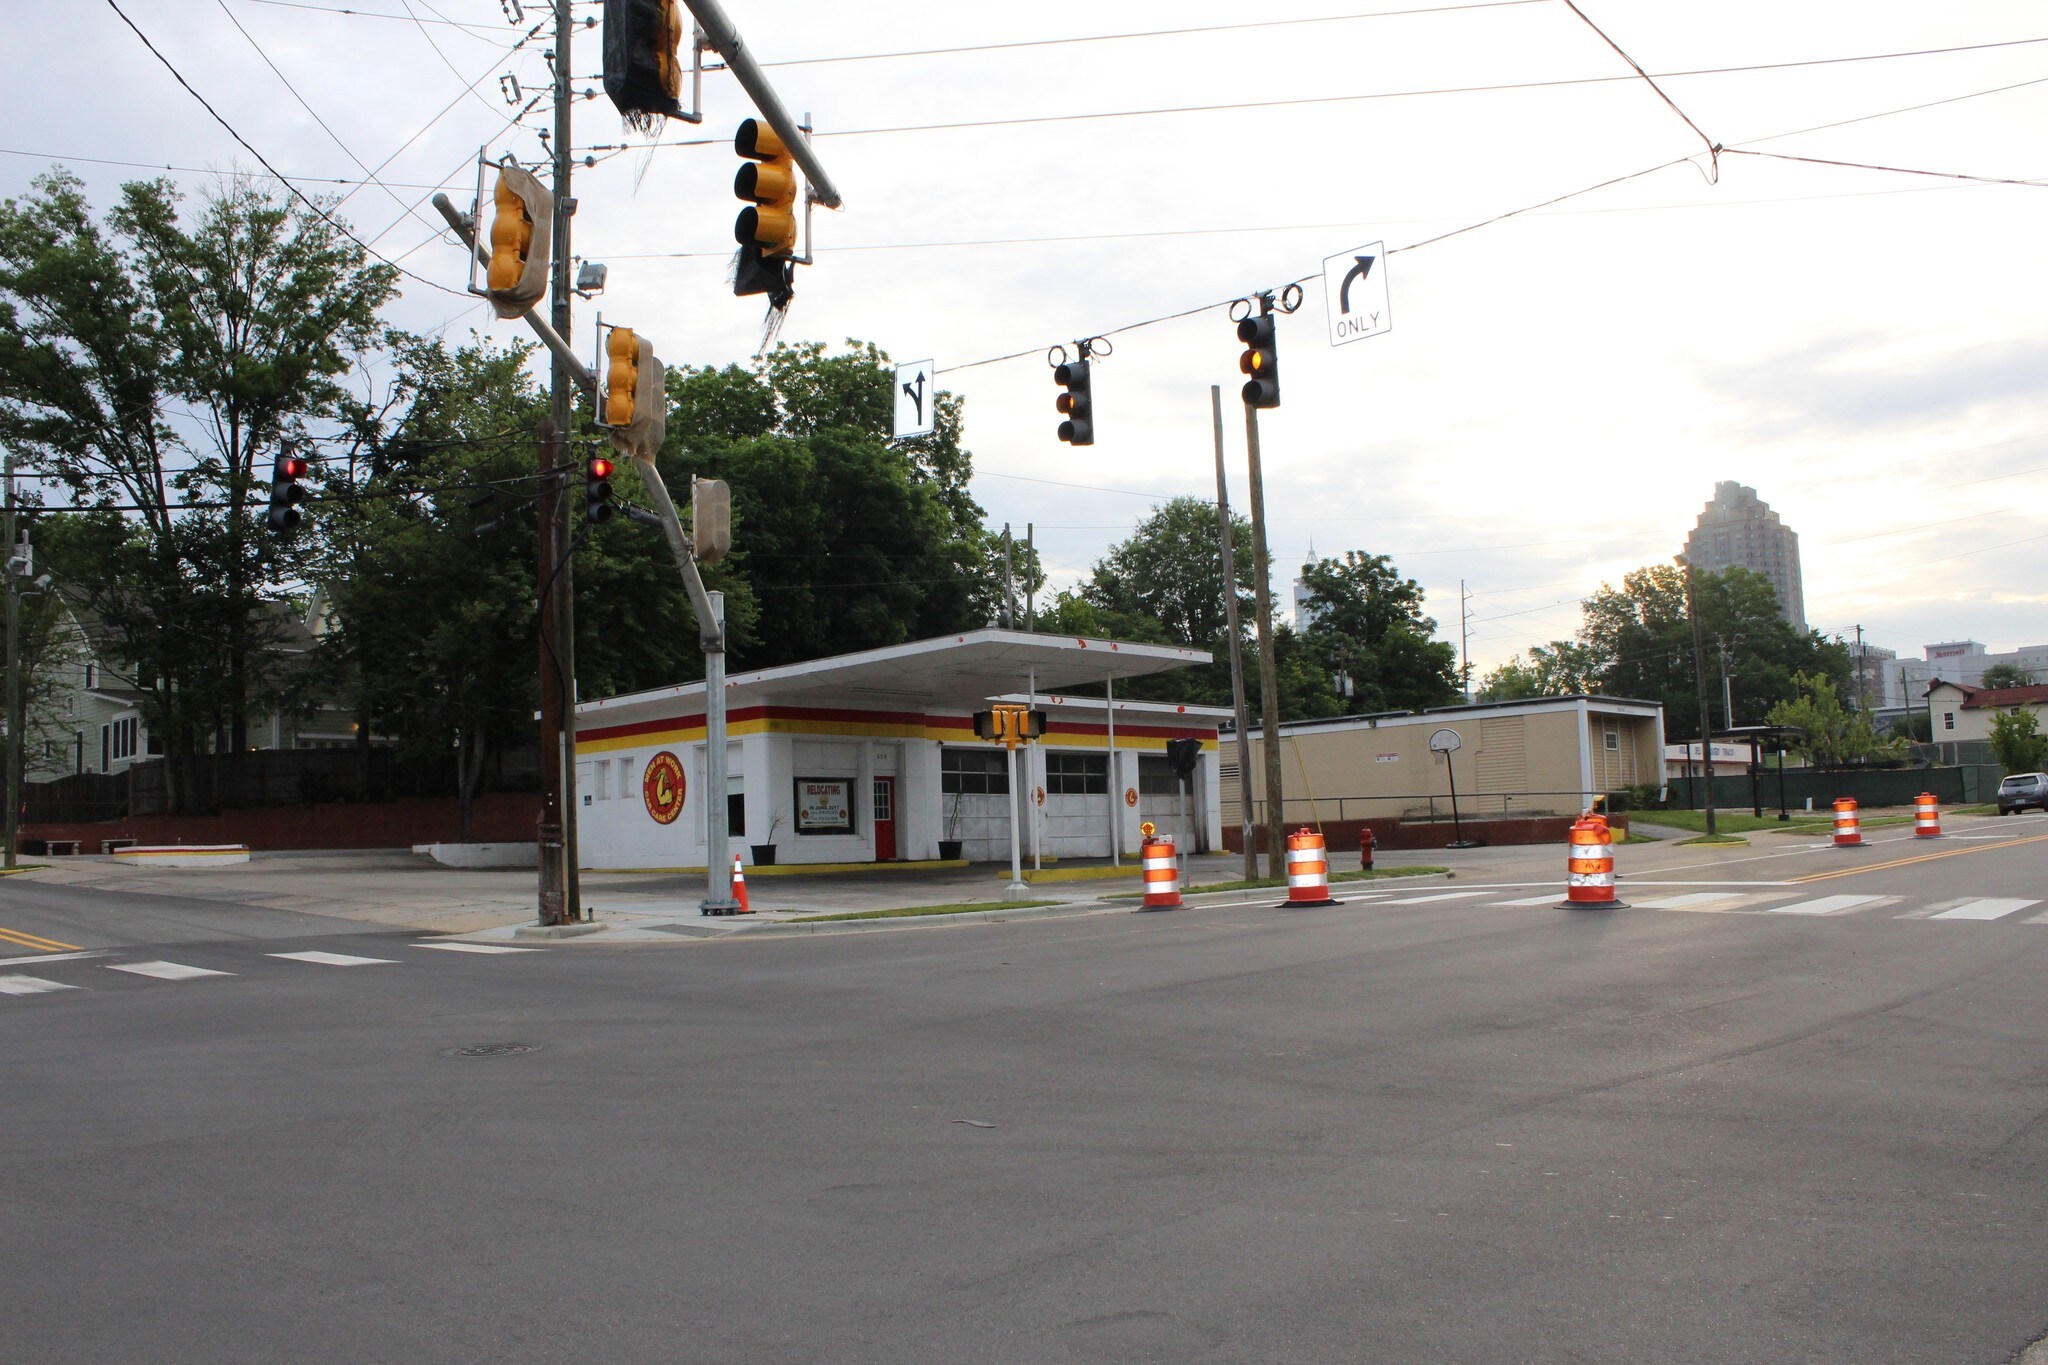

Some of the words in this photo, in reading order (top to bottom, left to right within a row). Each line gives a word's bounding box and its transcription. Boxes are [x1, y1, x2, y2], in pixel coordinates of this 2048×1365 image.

[1337, 311, 1380, 338] ONLY
[644, 761, 656, 783] MEN
[656, 755, 665, 765] AT
[665, 756, 682, 780] WORK
[807, 785, 841, 796] RELOCATING
[644, 790, 653, 811] CAR
[651, 809, 667, 822] CARE
[667, 788, 683, 820] CENTER
